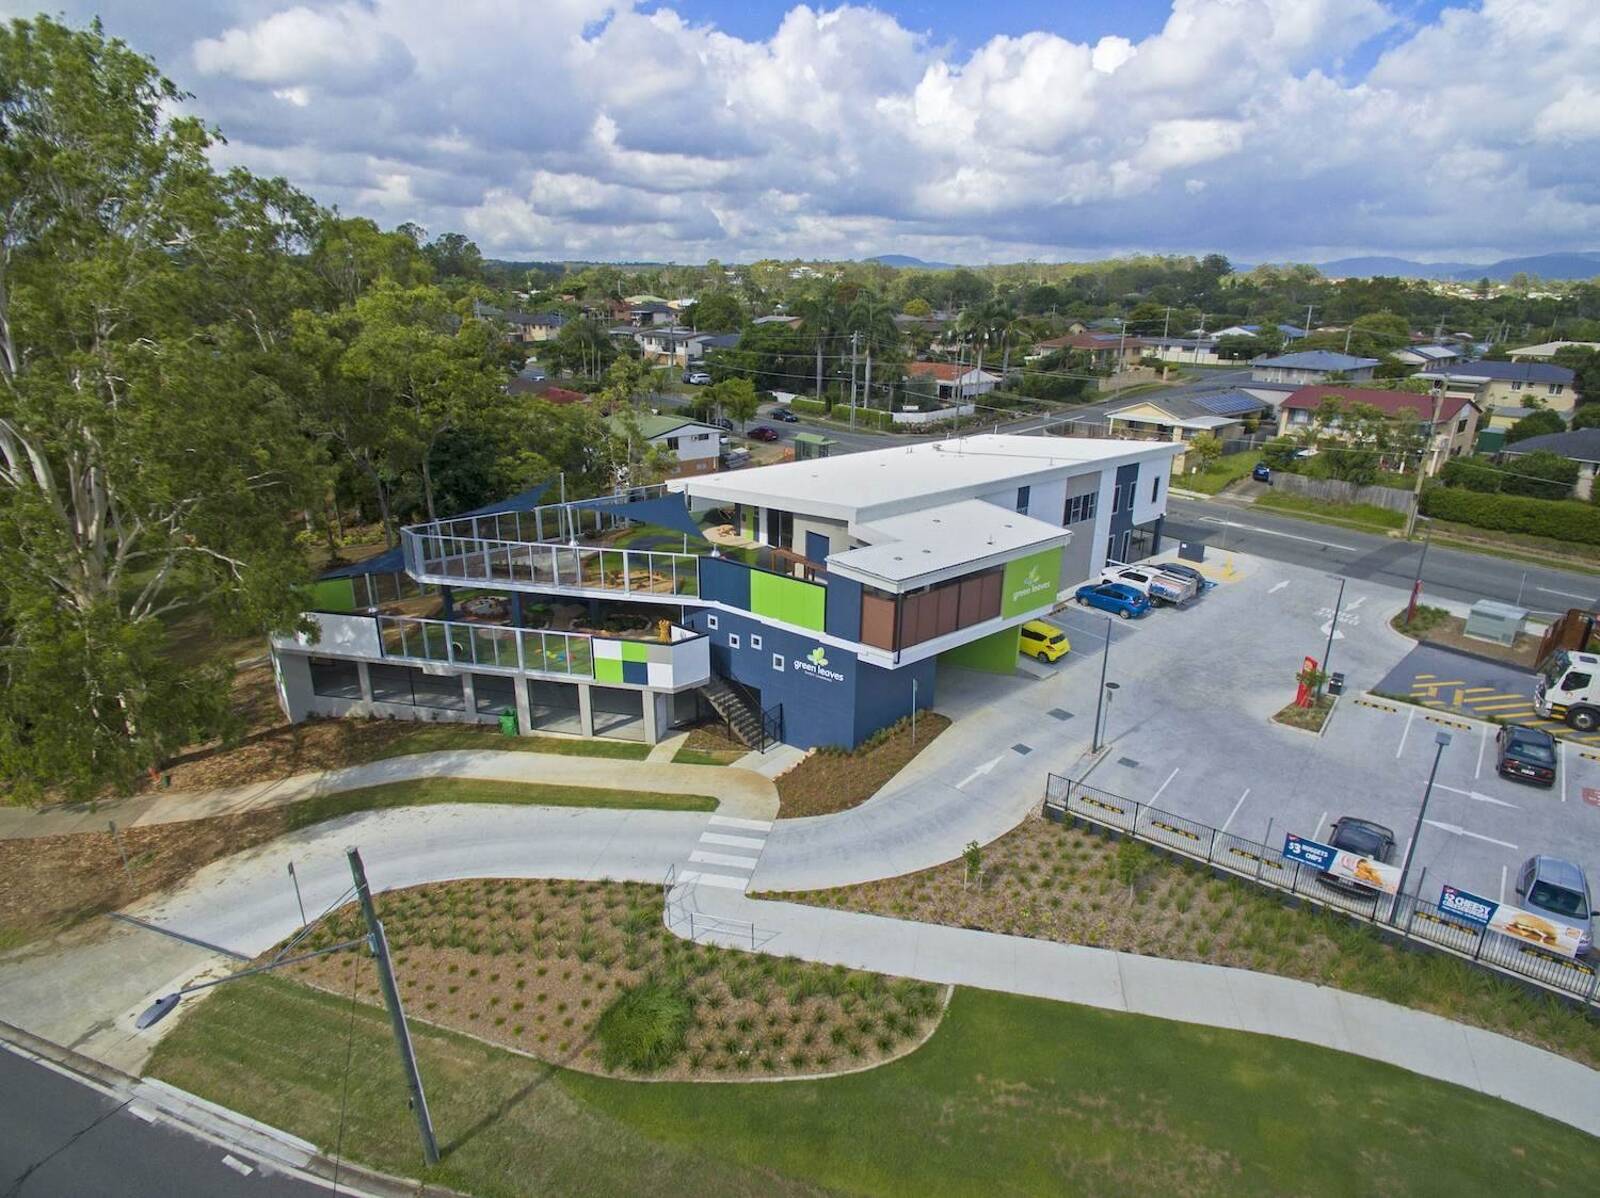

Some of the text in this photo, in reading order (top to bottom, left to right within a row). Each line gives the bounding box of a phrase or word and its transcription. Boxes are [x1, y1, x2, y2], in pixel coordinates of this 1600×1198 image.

[793, 660, 817, 672] green
[817, 665, 845, 682] leaves
[1288, 842, 1302, 854] $3
